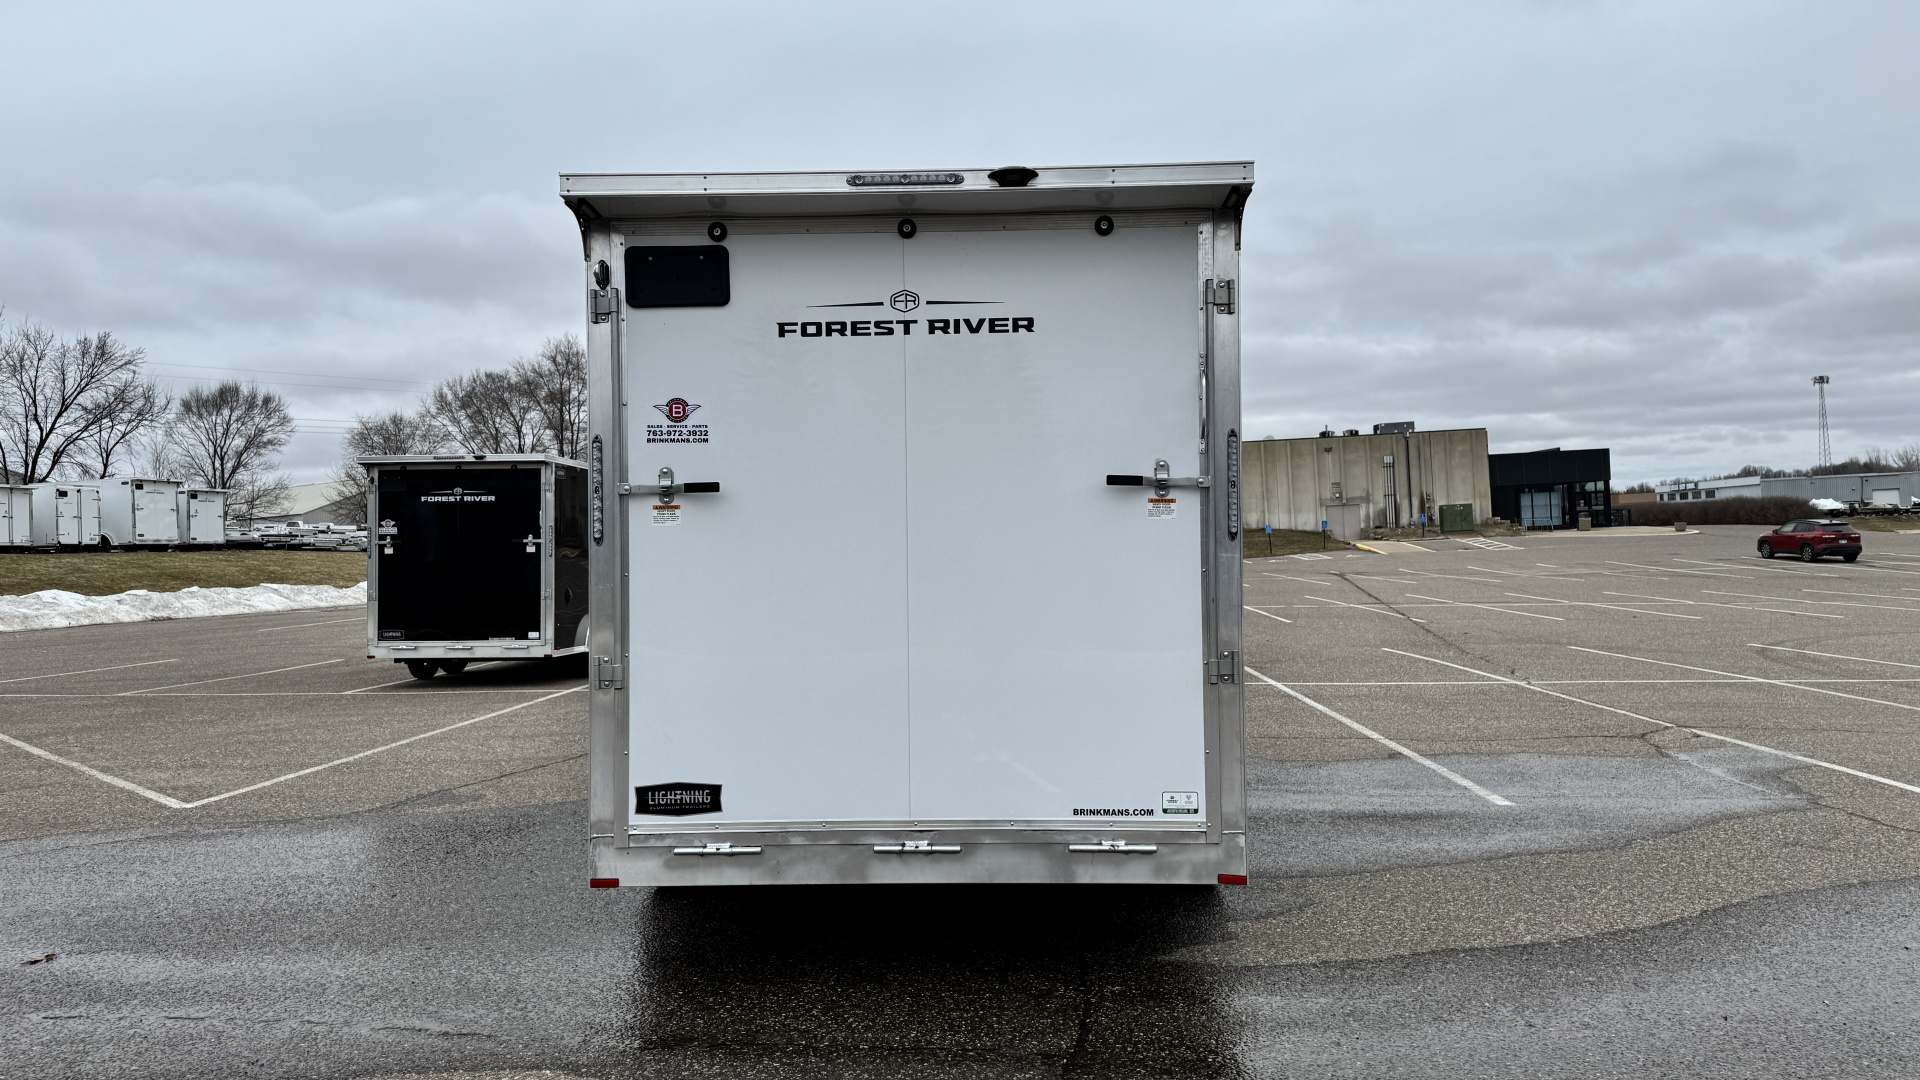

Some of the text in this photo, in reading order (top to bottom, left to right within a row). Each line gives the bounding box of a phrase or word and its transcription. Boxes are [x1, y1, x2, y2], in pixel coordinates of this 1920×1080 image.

[776, 316, 1035, 338] FOREST RIVER
[672, 404, 684, 417] B
[646, 429, 709, 437] 763-972-3932
[648, 790, 711, 805] LIGHTNING
[1073, 808, 1154, 816] BRINKMANS.COM
